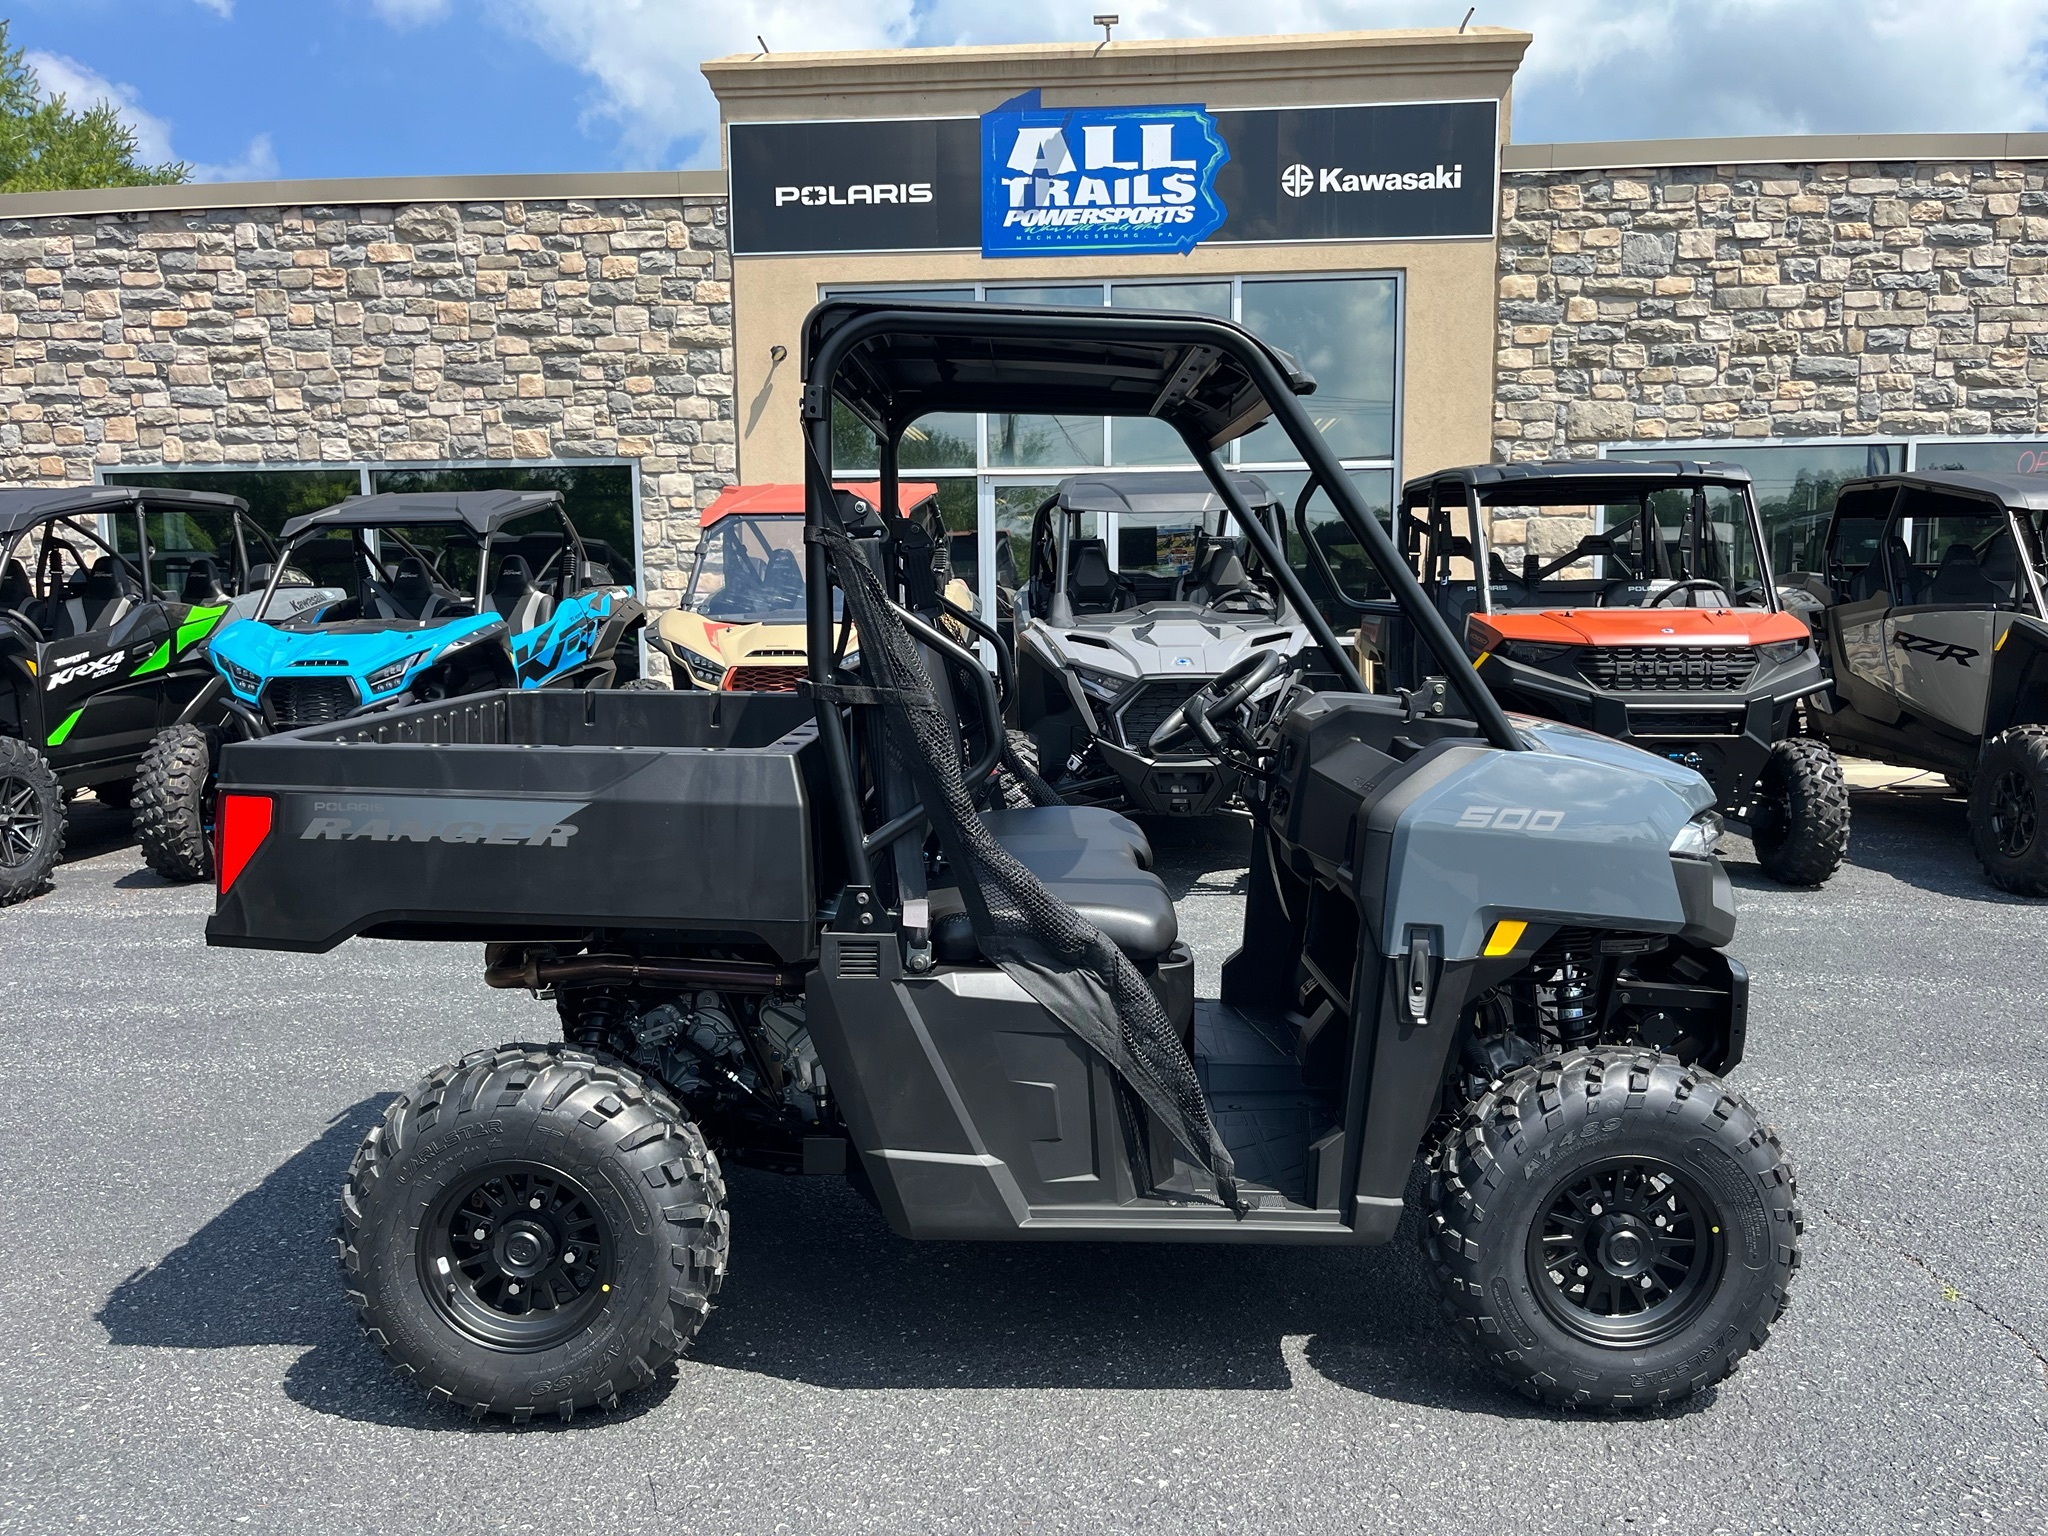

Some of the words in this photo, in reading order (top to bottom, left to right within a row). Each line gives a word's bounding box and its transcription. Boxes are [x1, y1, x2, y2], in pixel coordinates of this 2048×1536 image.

[1007, 124, 1196, 175] ALL
[1002, 173, 1196, 207] TRAILS
[1319, 164, 1462, 192] Kawasaki
[775, 183, 933, 206] POLARIS
[1003, 206, 1196, 227] POWERSPORTS
[1893, 630, 1980, 668] RZR
[46, 650, 126, 692] KRX4
[92, 665, 119, 680] 1000
[1615, 661, 1729, 676] POLARIS
[314, 801, 385, 813] POLARIS
[1454, 805, 1566, 832] 500
[299, 816, 580, 848] RANGER
[396, 1118, 504, 1185] CARLSTAR
[1522, 1117, 1624, 1181] AT489
[1629, 1323, 1739, 1389] CARLSTAR
